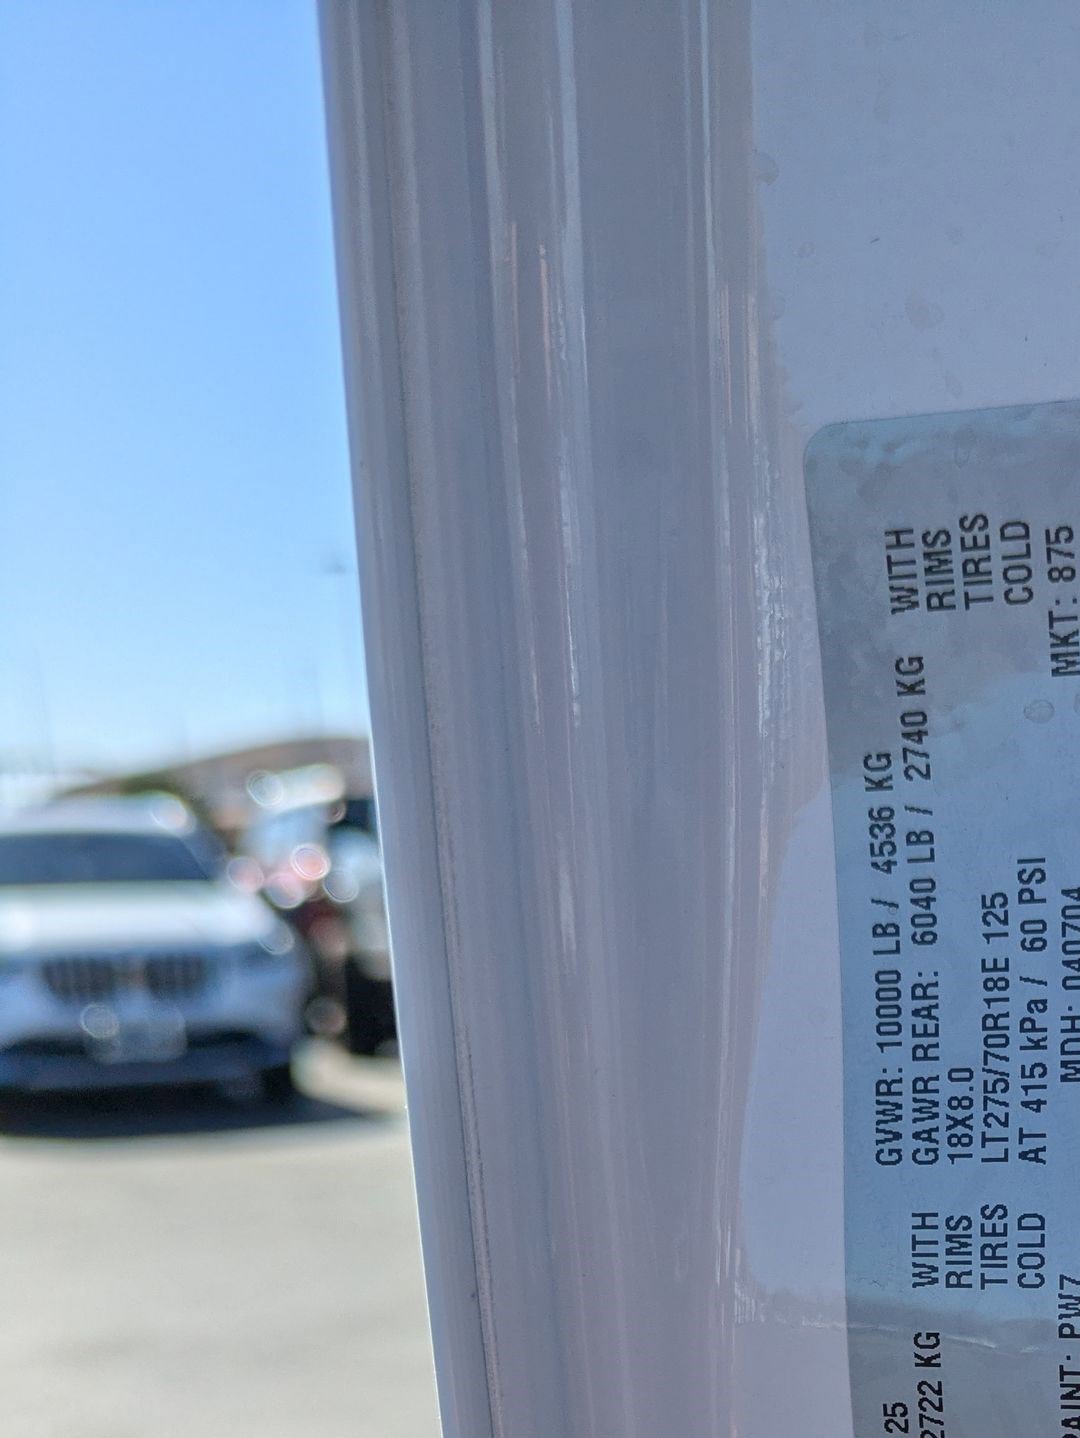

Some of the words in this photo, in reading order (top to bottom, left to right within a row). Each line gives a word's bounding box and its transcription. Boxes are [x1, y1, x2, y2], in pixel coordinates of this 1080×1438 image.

[885, 529, 919, 614] WITH
[922, 529, 956, 611] RIMS
[959, 514, 993, 610] TIRES
[1000, 521, 1033, 605] COLD
[1045, 526, 1075, 582] 875
[1048, 598, 1080, 676] MKT:
[895, 657, 925, 696] KG
[863, 753, 893, 791] KG
[900, 711, 930, 781] 2740
[868, 807, 897, 874] 4536
[905, 805, 932, 815] /
[906, 830, 934, 863] LB
[871, 899, 899, 909] /
[910, 878, 937, 945] 6040
[1017, 858, 1046, 904] PSI
[872, 923, 900, 955] LB
[981, 892, 1008, 944] 125
[1020, 919, 1047, 952] 60
[875, 970, 902, 1053] 10000
[1020, 976, 1047, 986] /
[911, 972, 939, 1061] REAR:
[1020, 999, 1047, 1050] kPa
[981, 958, 1009, 1162] LT275/70R18E
[1021, 1063, 1047, 1113] 415
[876, 1068, 902, 1165] GVWR:
[912, 1075, 939, 1165] GAWR
[946, 1068, 973, 1164] 18X8.0
[1019, 1128, 1046, 1164] AT
[912, 1213, 938, 1288] WITH
[945, 1216, 972, 1288] RIMS
[980, 1205, 1008, 1289] TIRES
[1017, 1213, 1045, 1288] COLD
[914, 1332, 941, 1367] KG
